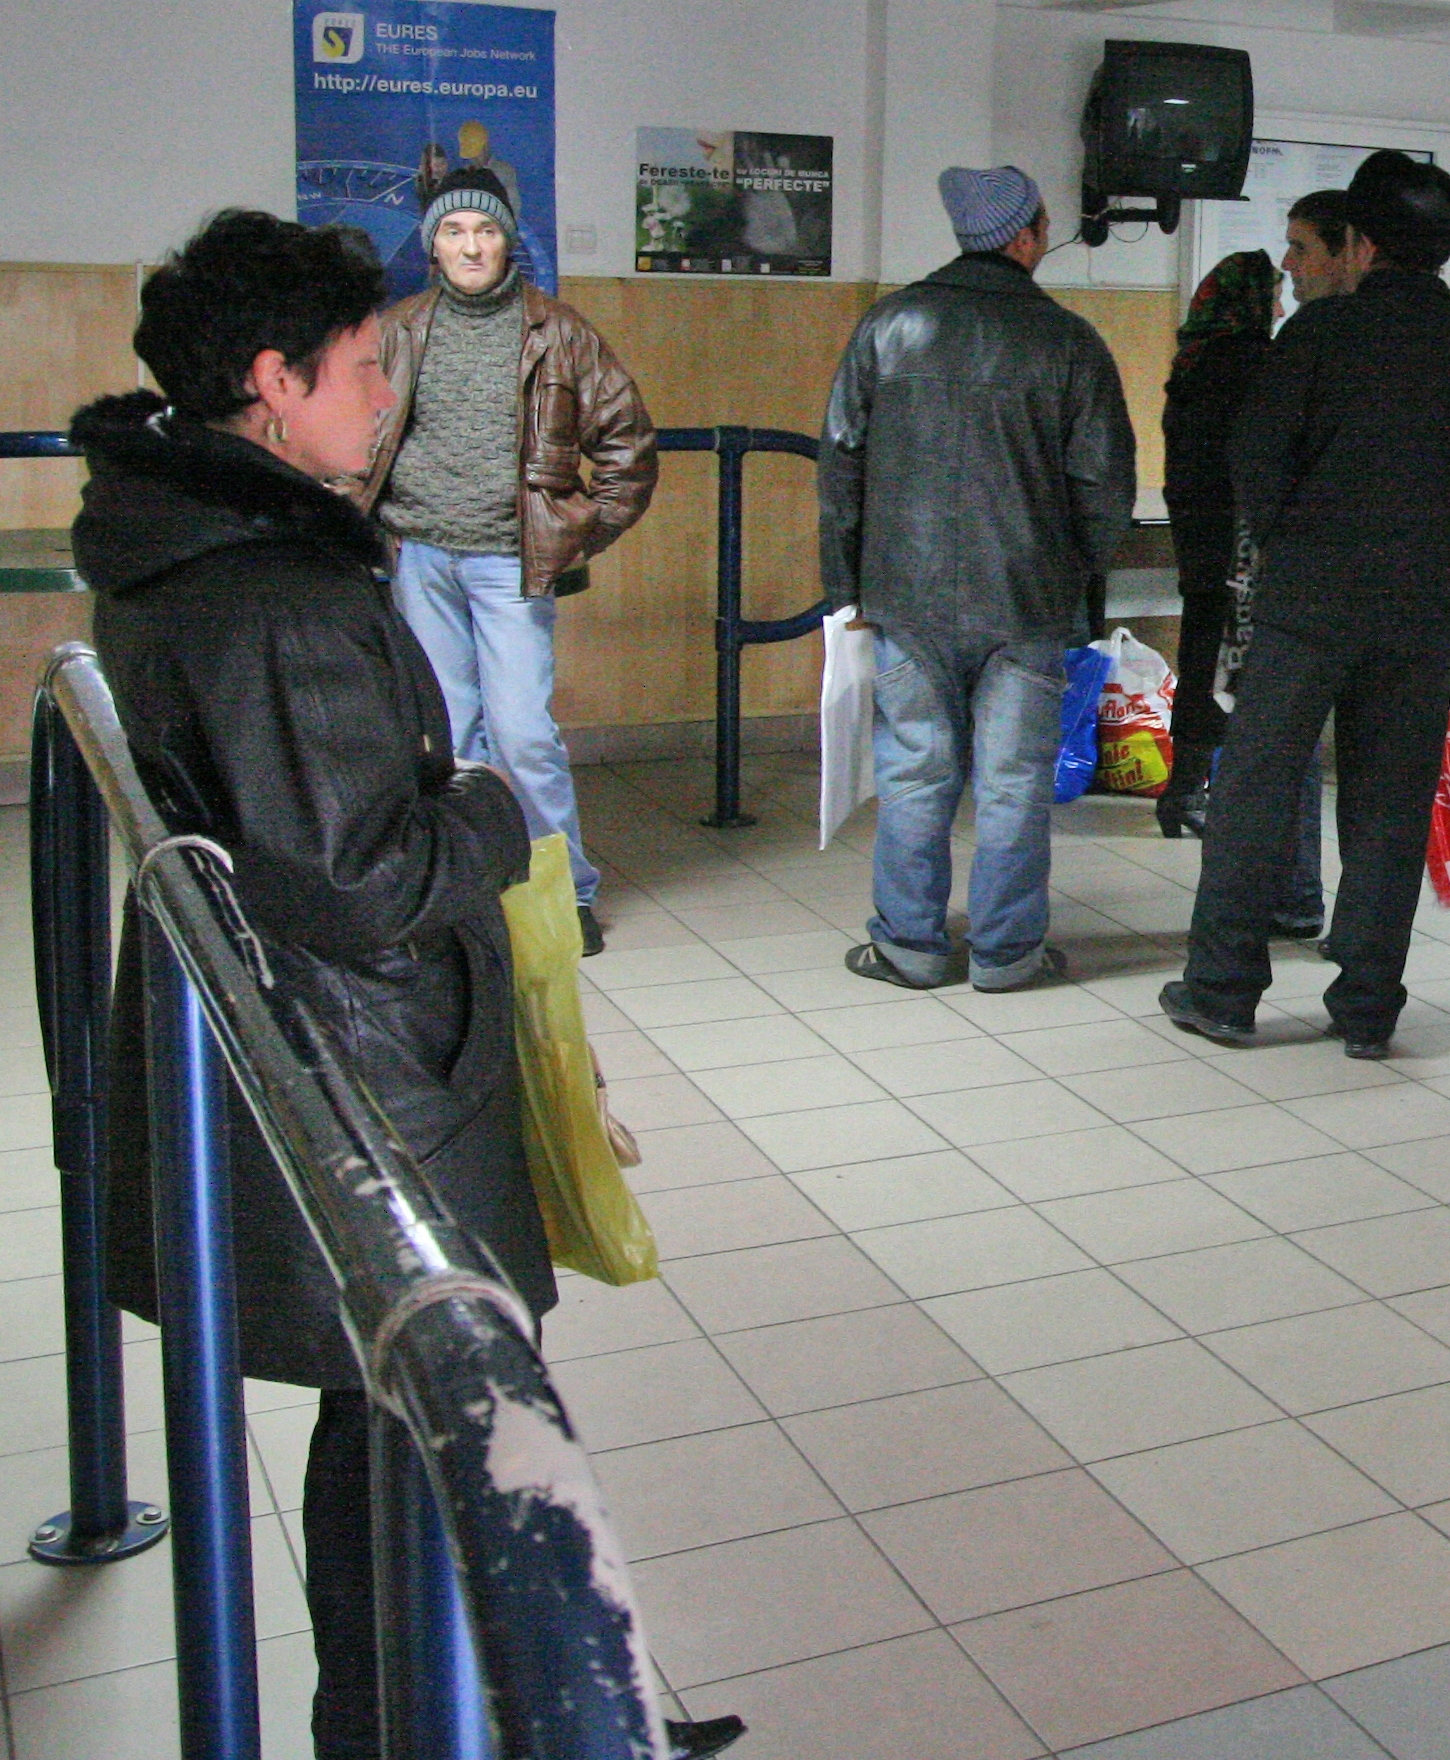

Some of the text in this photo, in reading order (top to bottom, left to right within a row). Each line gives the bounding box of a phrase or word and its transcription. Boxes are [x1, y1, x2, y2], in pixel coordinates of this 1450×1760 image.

[376, 23, 438, 40] EURES
[375, 42, 537, 61] THE European Jobs Network
[314, 73, 538, 98] http://eures.europa.eu
